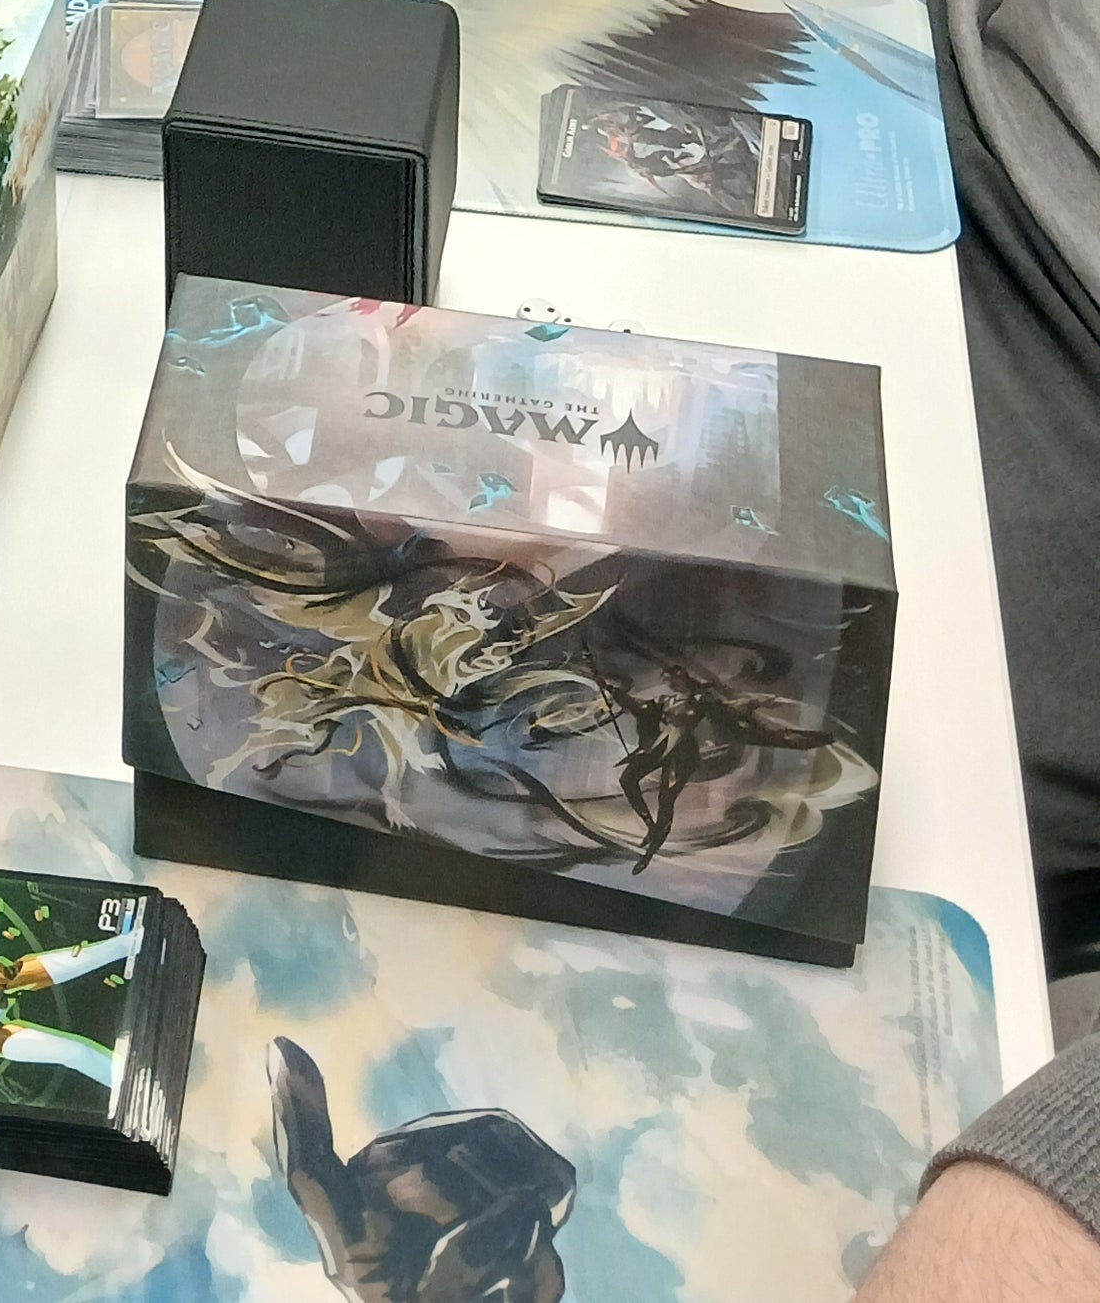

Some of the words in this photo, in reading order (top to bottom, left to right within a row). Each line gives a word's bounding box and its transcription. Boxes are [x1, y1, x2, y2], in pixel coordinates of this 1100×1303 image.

[444, 386, 555, 409] GATHERING
[564, 402, 600, 415] THE
[364, 391, 600, 446] MAGIC
[98, 897, 121, 932] P3
